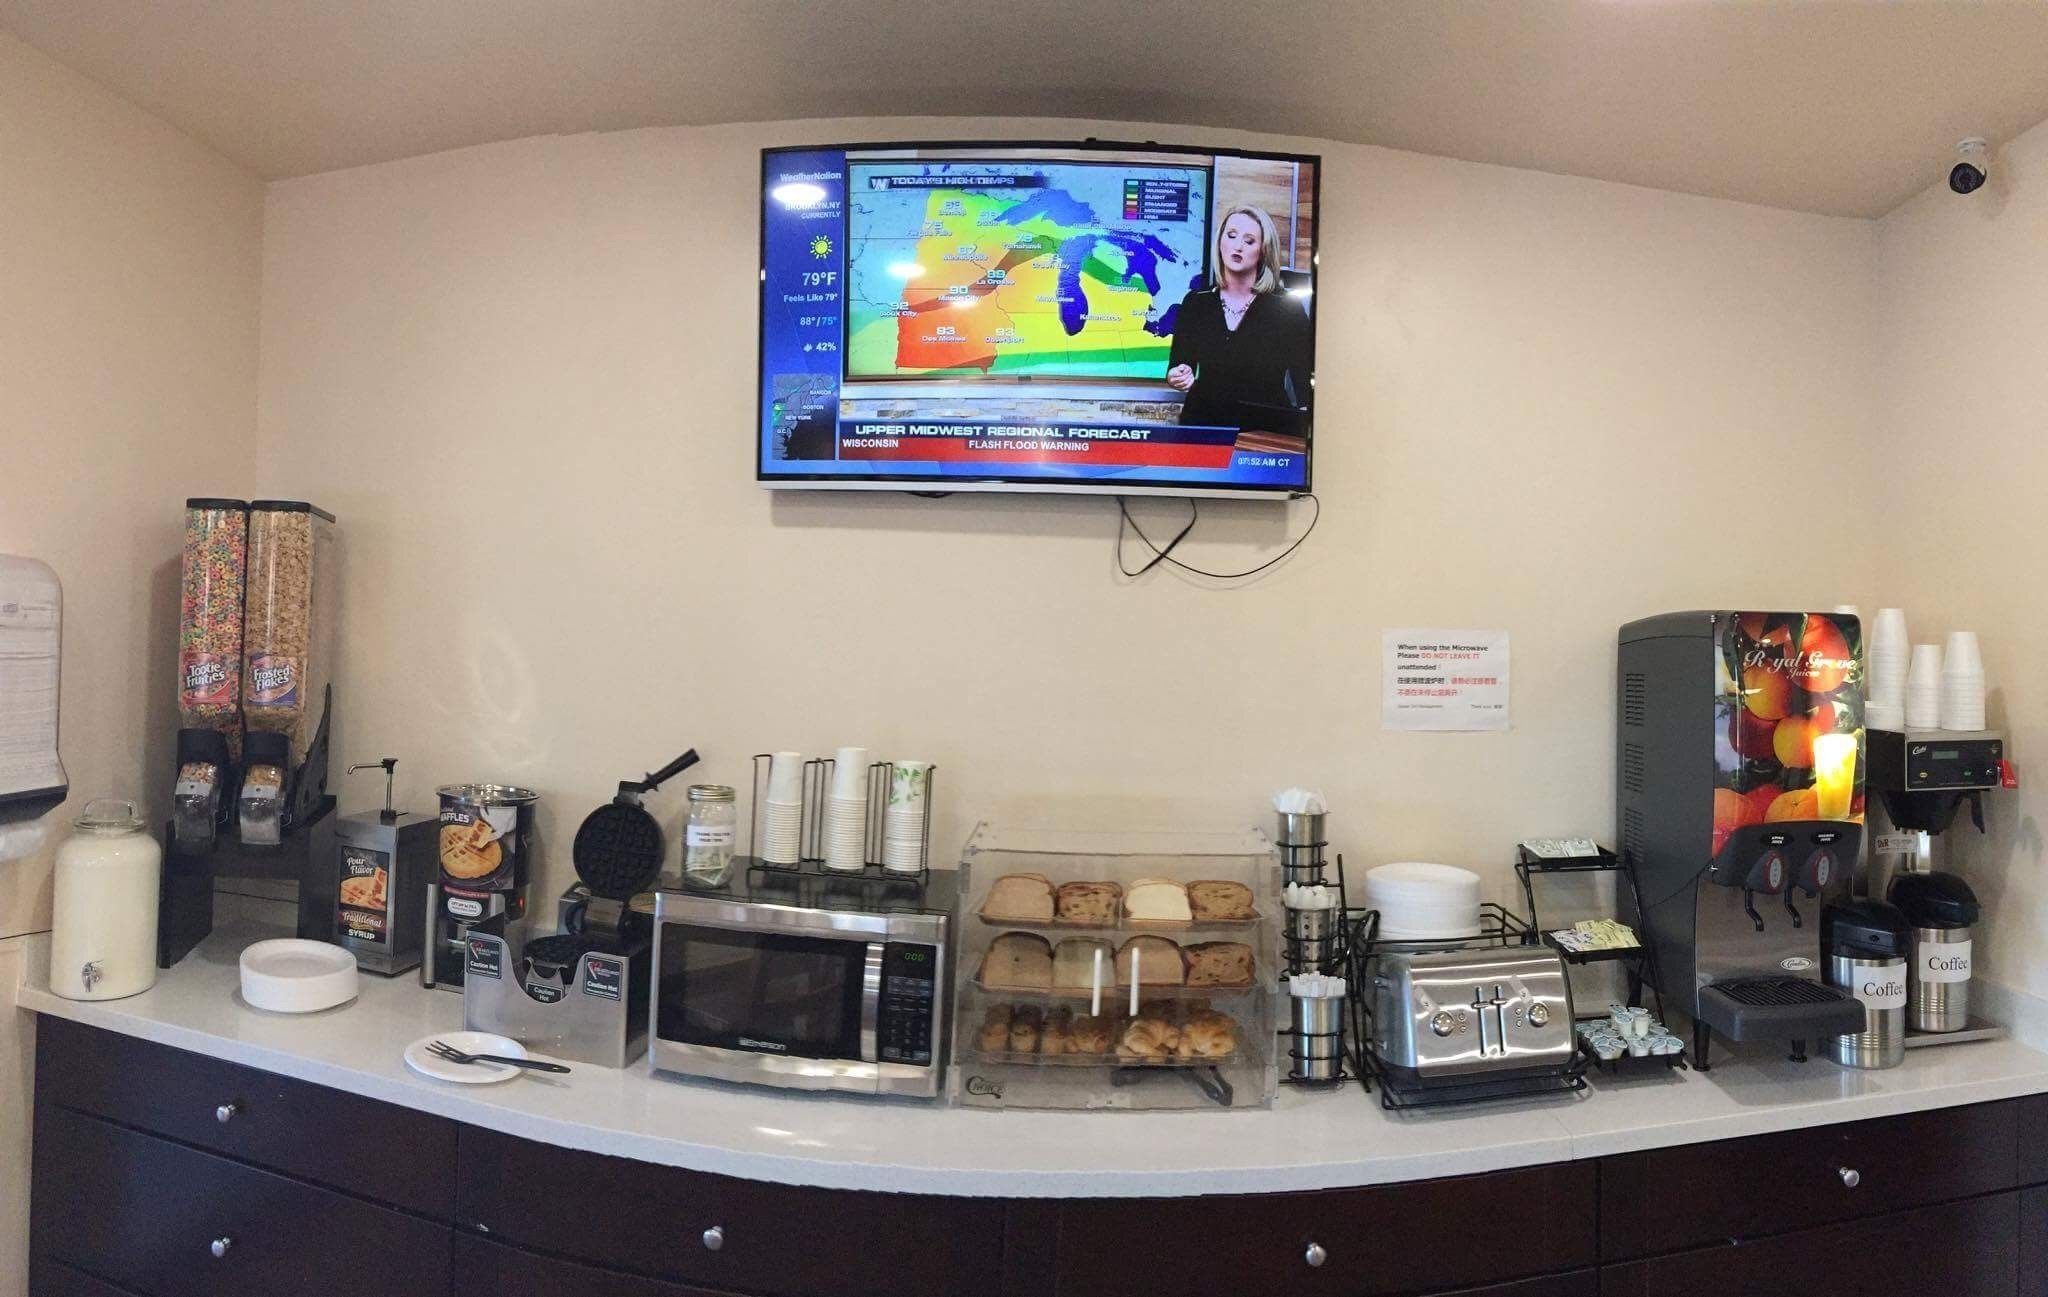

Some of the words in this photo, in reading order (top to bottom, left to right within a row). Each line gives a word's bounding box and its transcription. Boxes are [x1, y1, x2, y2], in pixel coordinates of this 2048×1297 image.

[891, 177, 943, 185] TODAY'S
[783, 294, 805, 303] Feels
[806, 293, 824, 302] Like
[815, 341, 837, 352] 42%
[855, 424, 905, 435] UPPER
[909, 425, 983, 436] MIDWEST
[987, 427, 1064, 438] REGIONAL
[1068, 428, 1151, 440] FORECAST
[842, 438, 899, 449] WISCONSIN
[968, 440, 1002, 450] FLASH
[1003, 440, 1038, 450] FLOOD
[1040, 441, 1090, 453] WARNING
[1261, 458, 1276, 466] AM
[1277, 458, 1290, 467] CT
[1418, 644, 1438, 652] using
[1397, 652, 1420, 660] Please
[189, 662, 221, 676] Tootie
[1397, 663, 1437, 671] unattended
[253, 665, 290, 681] Frosted
[255, 674, 290, 692] Flakes
[346, 856, 366, 866] Pour
[350, 864, 375, 875] Flavor
[342, 910, 384, 929] Traditional
[348, 928, 376, 940] SYRUP
[1928, 955, 1968, 971] Coffee
[533, 986, 555, 997] Caution
[1863, 981, 1903, 997] Coffee
[539, 994, 550, 1002] Hot
